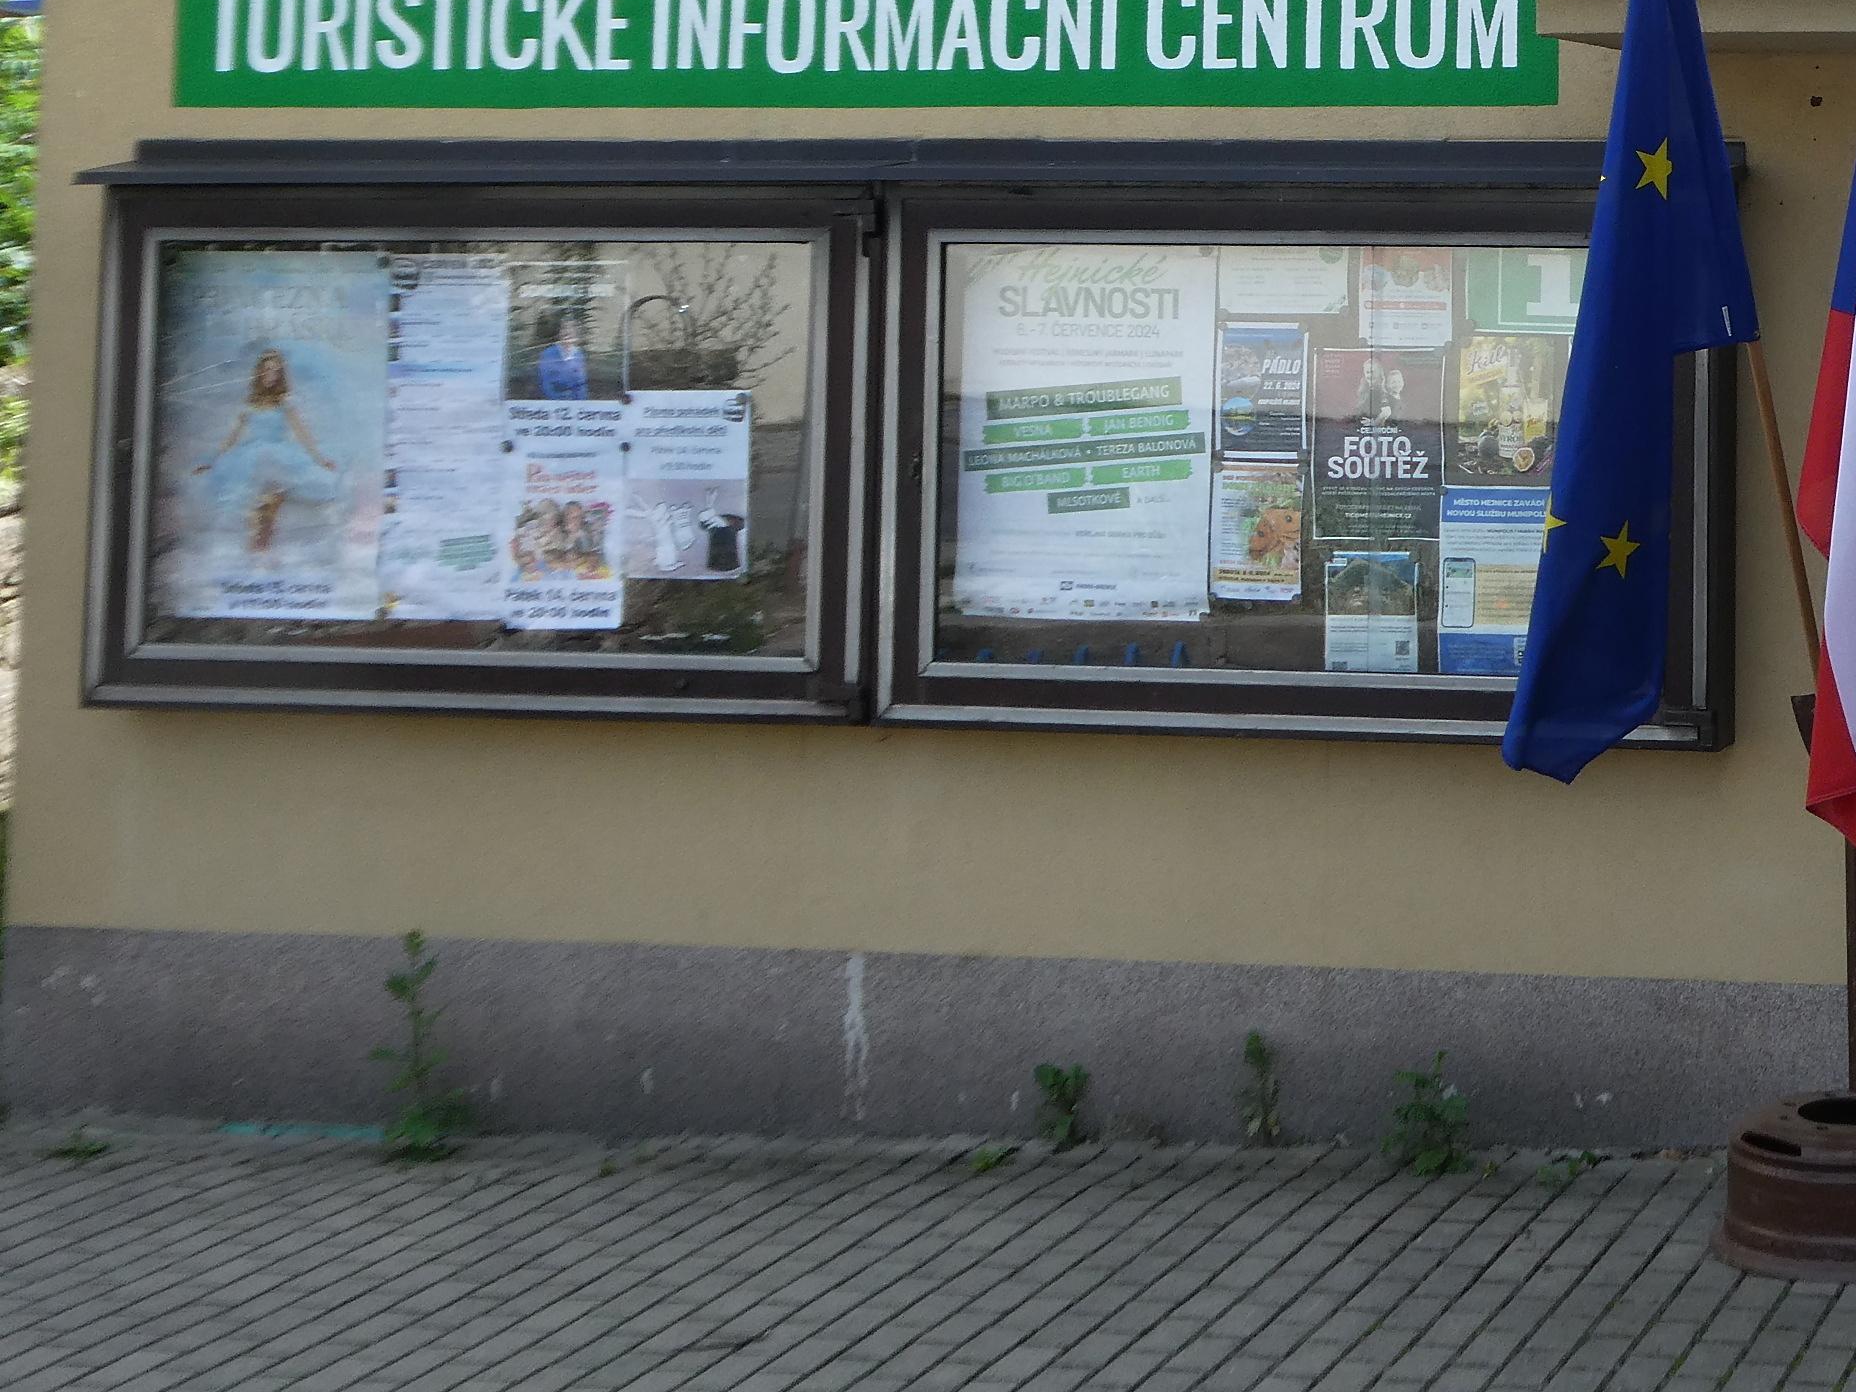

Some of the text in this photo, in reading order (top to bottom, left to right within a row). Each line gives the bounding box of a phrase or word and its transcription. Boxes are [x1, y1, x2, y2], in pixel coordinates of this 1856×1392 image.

[998, 285, 1180, 320] SLAVNOSTI
[1053, 321, 1124, 338] ČERVENCE
[1127, 324, 1160, 338] 2024
[1261, 355, 1301, 375] PÁDLO
[1000, 384, 1170, 410] MARPO & TROUBLEGANG
[1013, 414, 1174, 438] VESNA JAN BENDIG
[1096, 443, 1135, 457] TEREZA
[1137, 438, 1197, 453] BALONOVÁ
[1343, 436, 1412, 458] FOTO
[1121, 465, 1161, 480] EARTH
[1327, 451, 1429, 479] SOUTĚŽ
[1453, 497, 1479, 507] MĚSTO
[1480, 499, 1512, 507] HEJNICE
[1446, 509, 1476, 517] NOVOU
[1476, 508, 1506, 518] SLUŽBU
